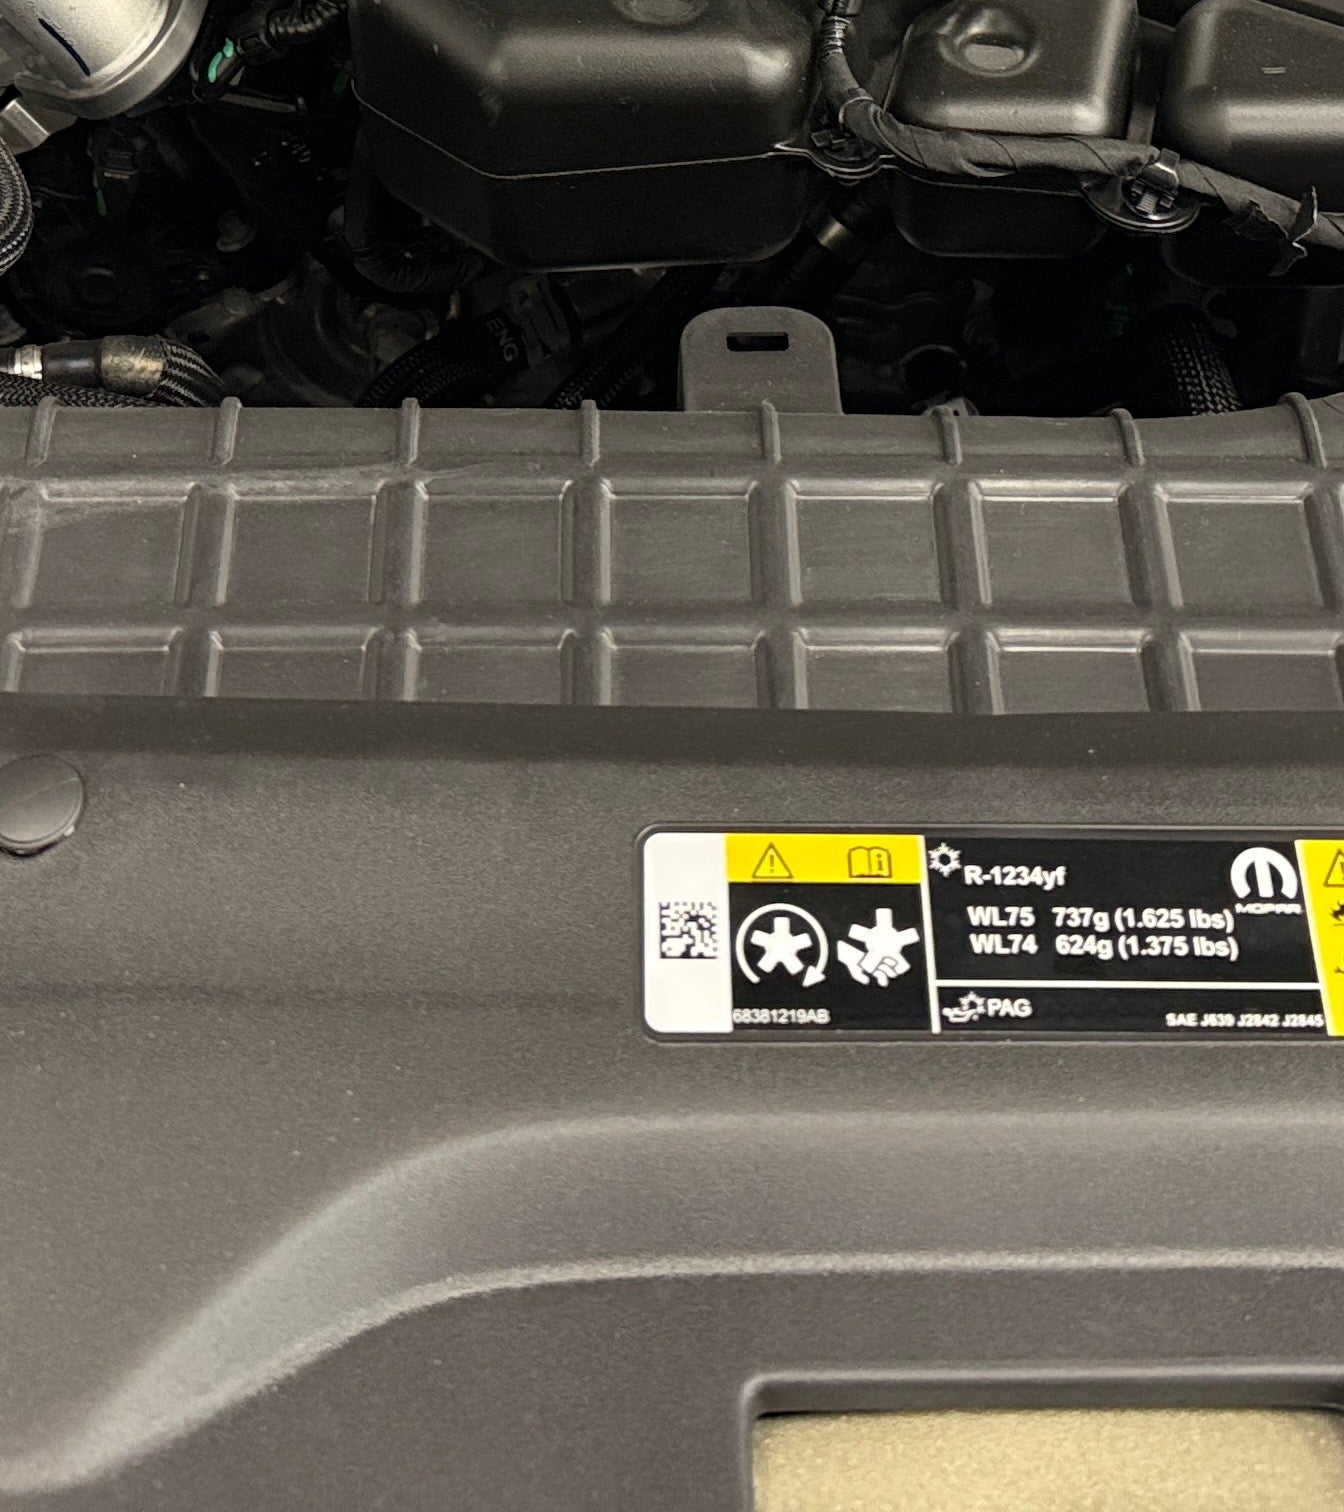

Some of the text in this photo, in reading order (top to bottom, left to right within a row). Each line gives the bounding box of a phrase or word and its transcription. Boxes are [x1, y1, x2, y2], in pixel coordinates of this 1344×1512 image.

[963, 864, 1067, 891] R-1234yf
[1234, 902, 1304, 915] MOPAR
[966, 905, 1235, 934] WL75 737g (1.625 lbs)
[968, 933, 1239, 962] WL74 624g (1.375 lbs)
[732, 1008, 832, 1025] 68381219AB
[986, 998, 1034, 1018] PAG
[1165, 1012, 1199, 1027] SAE
